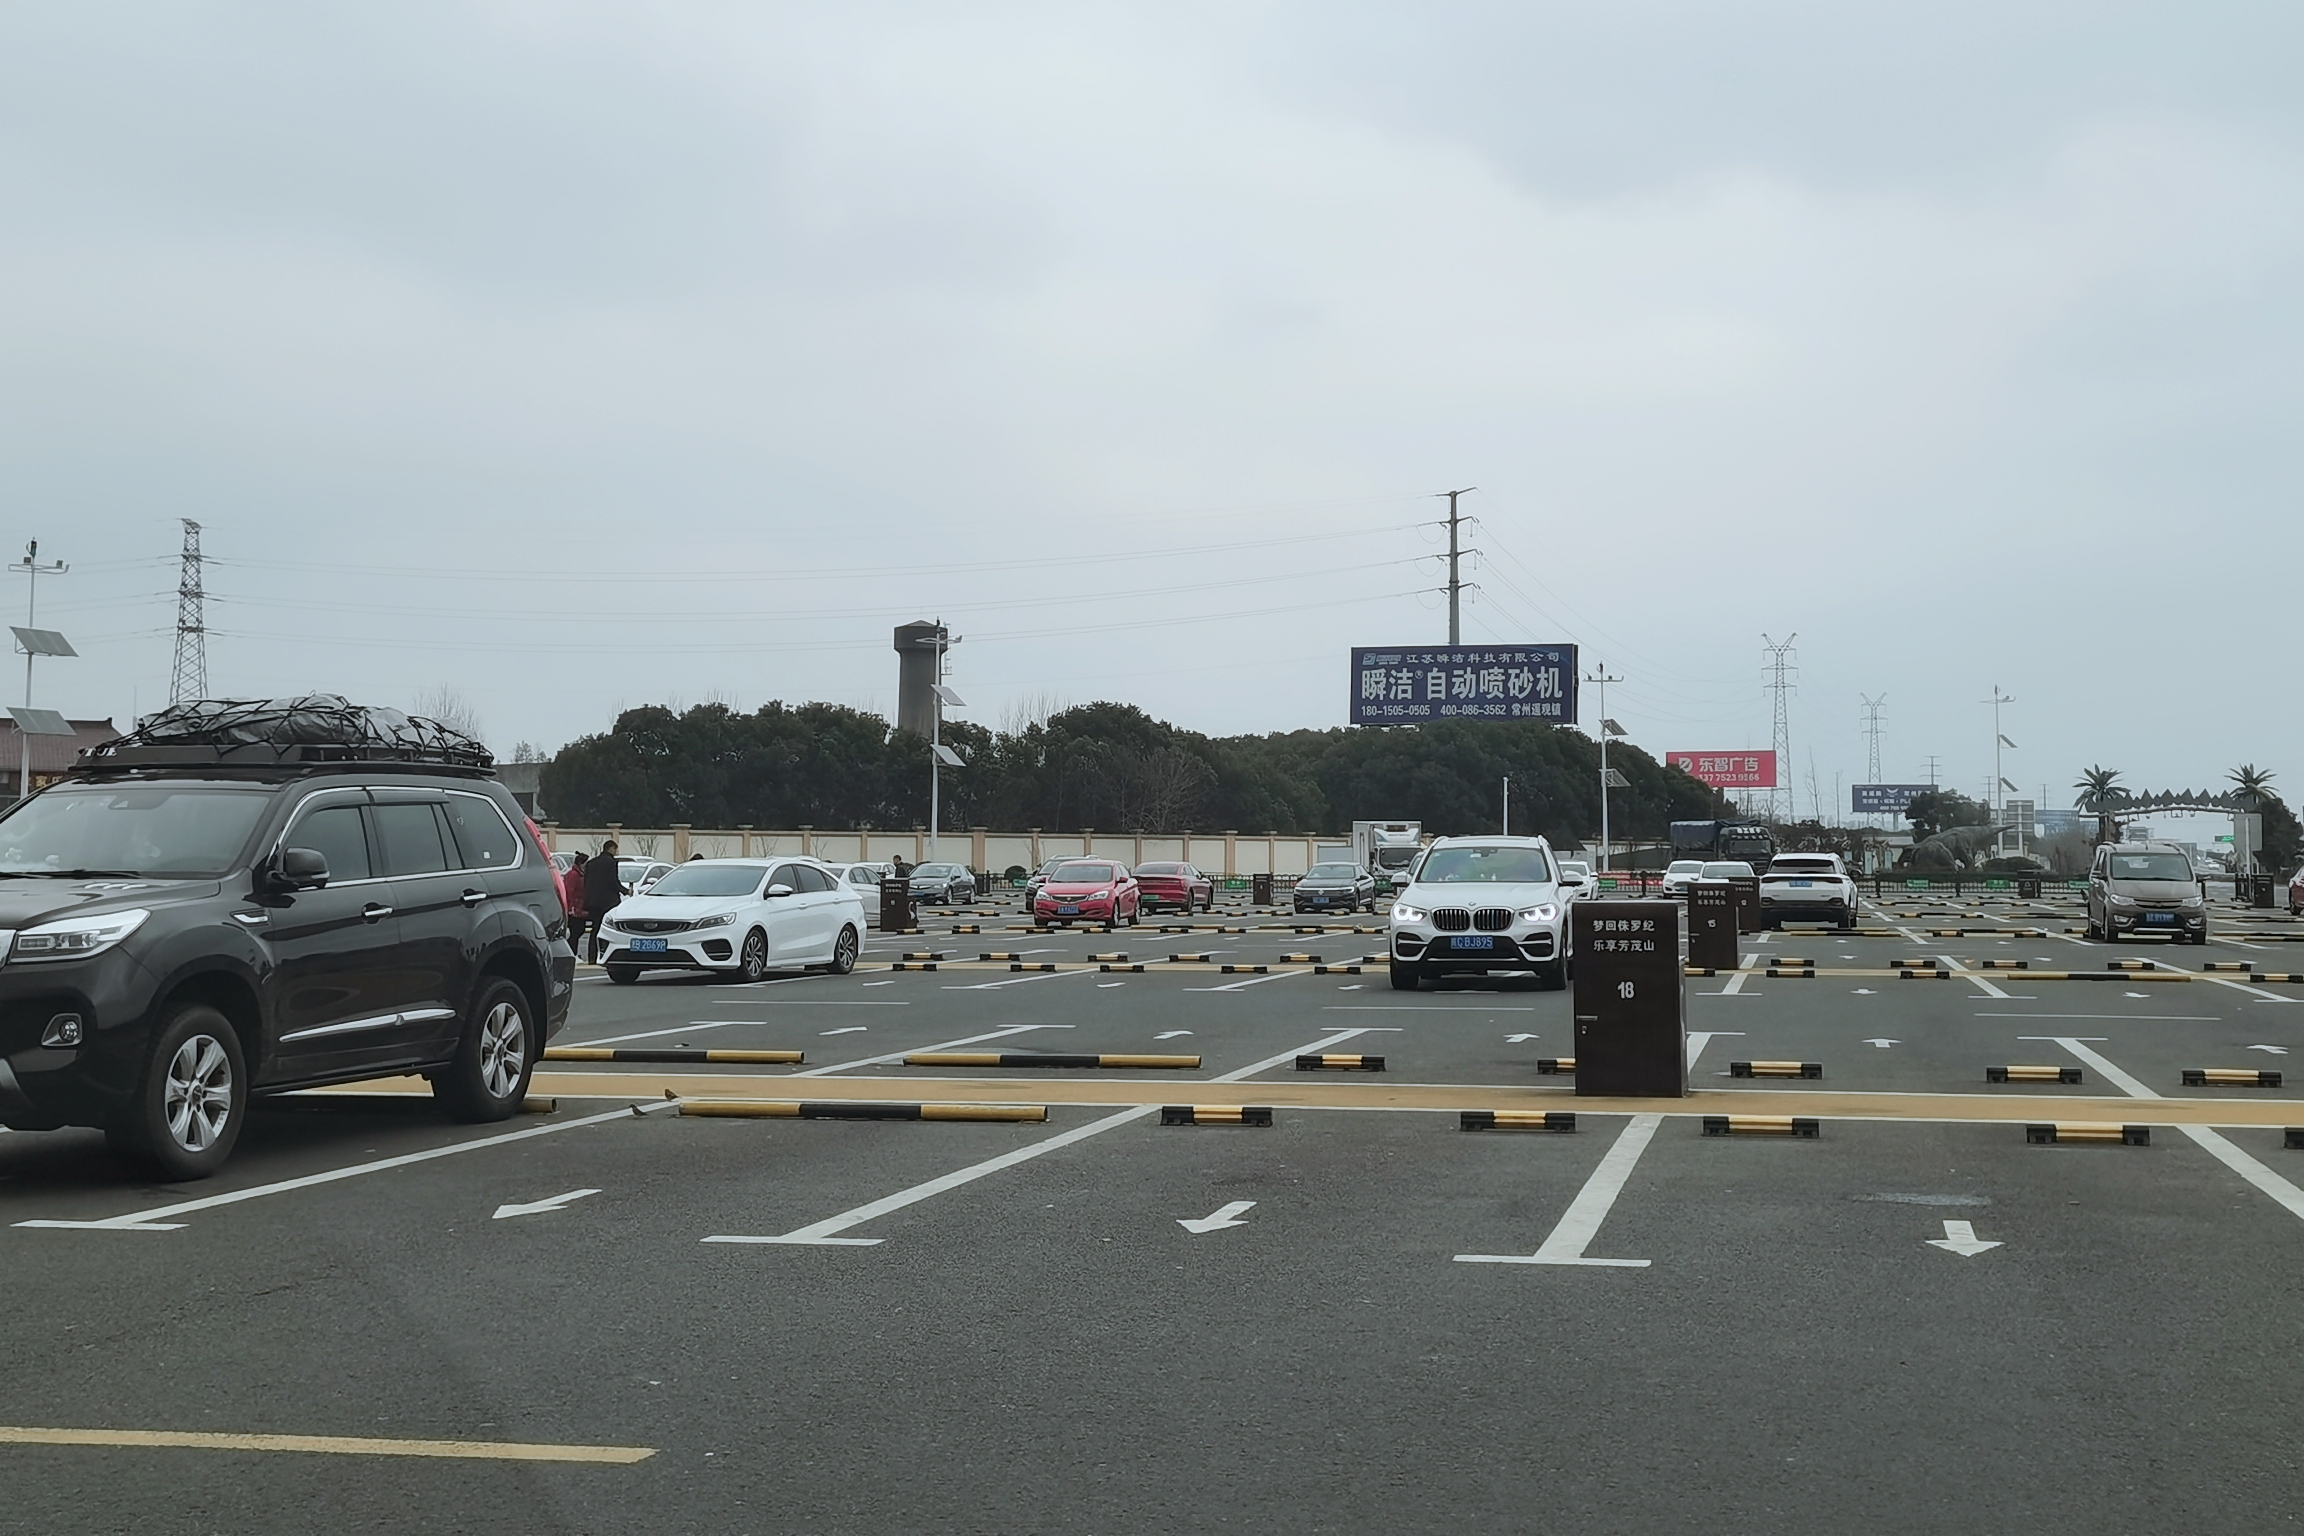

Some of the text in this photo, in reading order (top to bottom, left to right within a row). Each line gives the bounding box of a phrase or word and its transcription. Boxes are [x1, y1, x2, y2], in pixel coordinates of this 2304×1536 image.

[1361, 704, 1431, 716] 180-1505-0505
[1440, 704, 1507, 716] 400-086-3562
[1698, 757, 1759, 773] 东智广告
[1592, 920, 1655, 932] 梦回侏罗纪
[1593, 939, 1655, 952] 乐享芳茂山
[1617, 981, 1635, 999] 18
